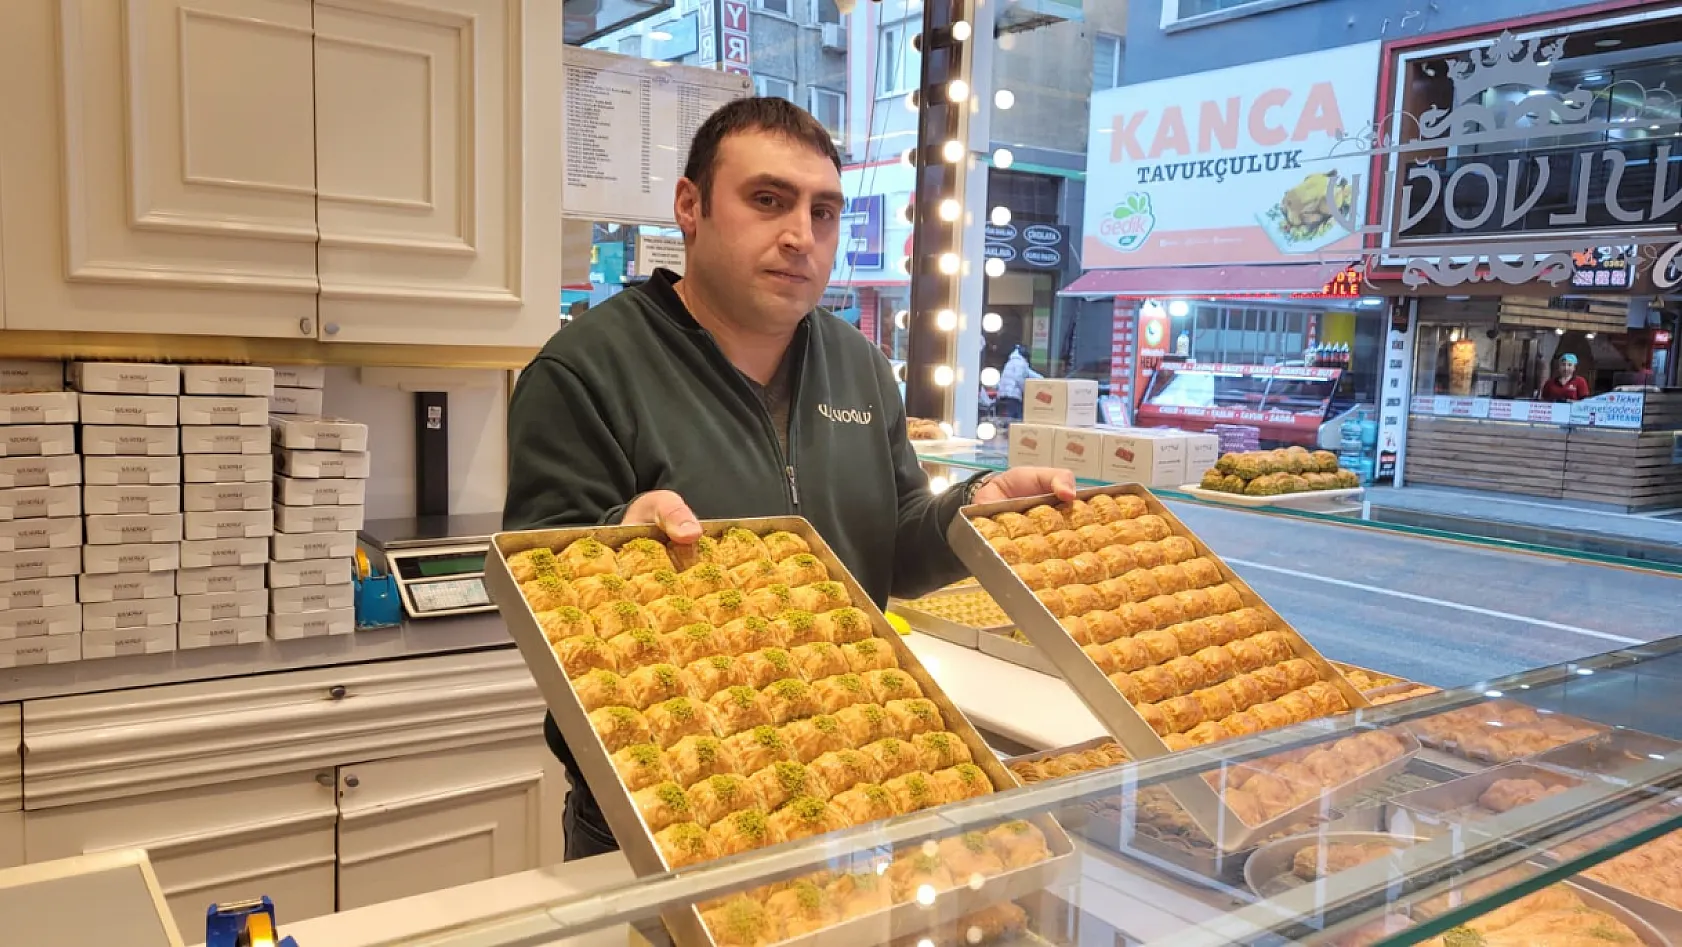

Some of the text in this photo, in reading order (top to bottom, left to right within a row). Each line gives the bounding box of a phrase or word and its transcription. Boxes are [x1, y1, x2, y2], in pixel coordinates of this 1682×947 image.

[1109, 81, 1344, 164] KANCA
[1137, 149, 1303, 183] TAVUKÇULUK
[1100, 215, 1146, 236] Gedik
